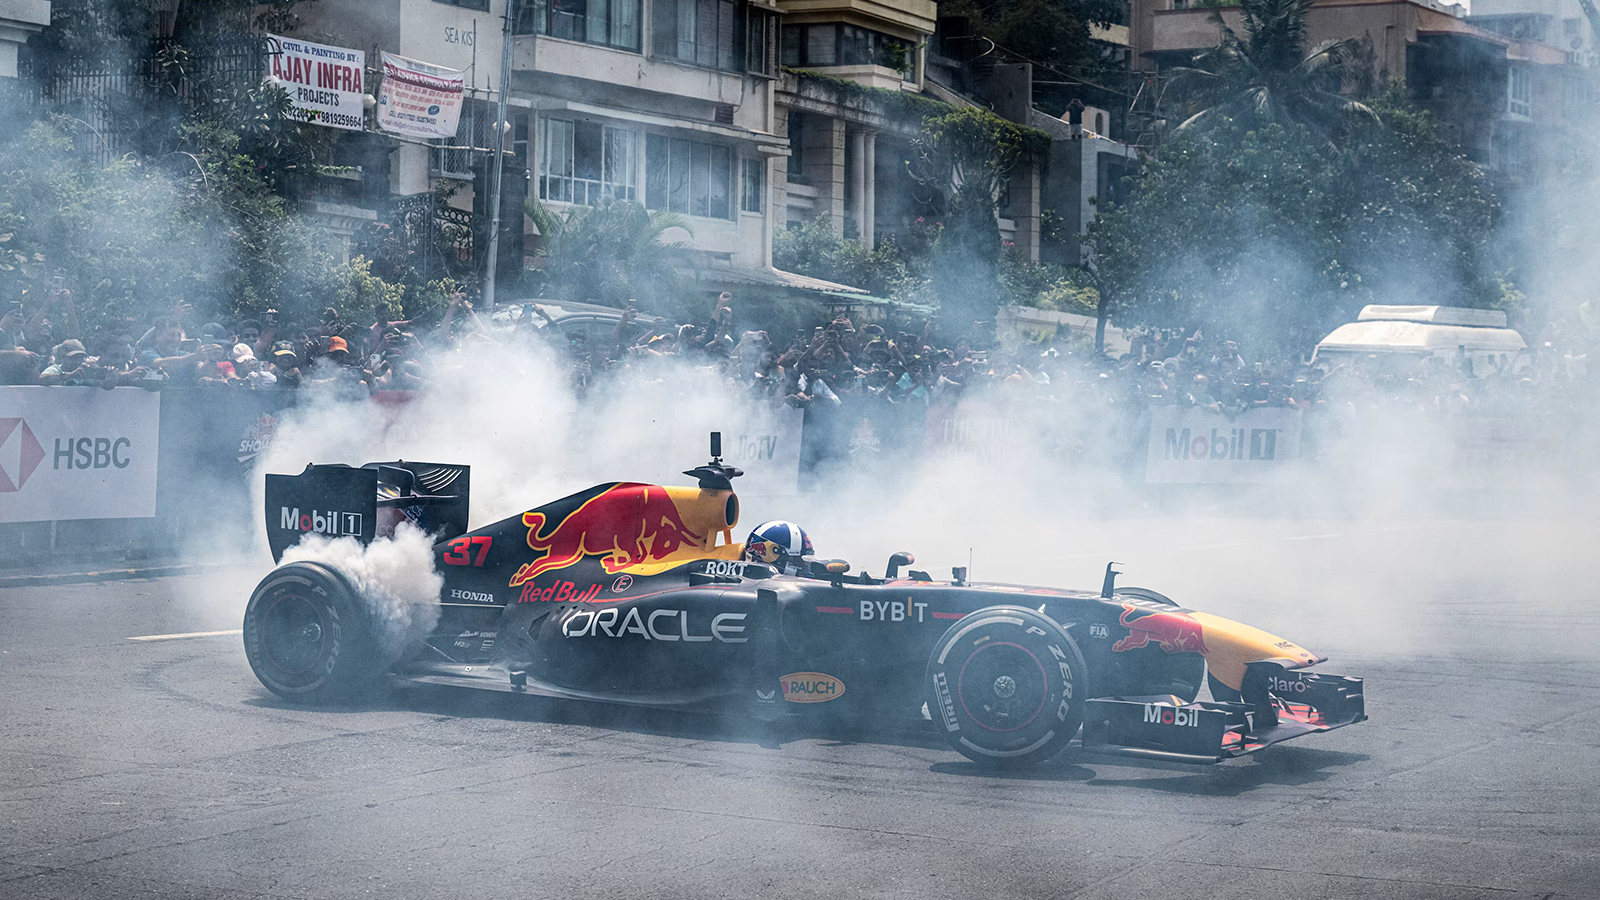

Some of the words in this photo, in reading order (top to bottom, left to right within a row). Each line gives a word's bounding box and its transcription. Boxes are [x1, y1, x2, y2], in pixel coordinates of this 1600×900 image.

[444, 26, 459, 44] SEA
[283, 41, 302, 53] CIVIL
[304, 46, 310, 54] &
[311, 48, 346, 60] PAINTING
[273, 54, 312, 86] AJAY
[317, 61, 362, 93] INFRA
[298, 87, 339, 106] PROJECTS
[321, 111, 362, 127] 9819259664
[53, 437, 131, 469] HSBC
[737, 435, 778, 460] JioTV
[1164, 428, 1245, 460] Mobil
[281, 506, 338, 534] Mobil
[443, 535, 493, 567] 37
[705, 561, 748, 577] ROKT
[450, 589, 494, 603] HONDA
[518, 579, 561, 603] Red
[554, 581, 603, 603] Bull
[860, 597, 928, 623] BYBIT
[312, 585, 328, 597] P
[325, 605, 342, 675] ZERO
[562, 607, 749, 643] ORACLE
[1090, 626, 1107, 636] FIA
[1025, 626, 1047, 636] P
[1048, 644, 1073, 722] ZERO
[790, 681, 836, 695] RAUCH
[933, 672, 960, 732] PIRELLI
[1143, 704, 1199, 728] Mobil
